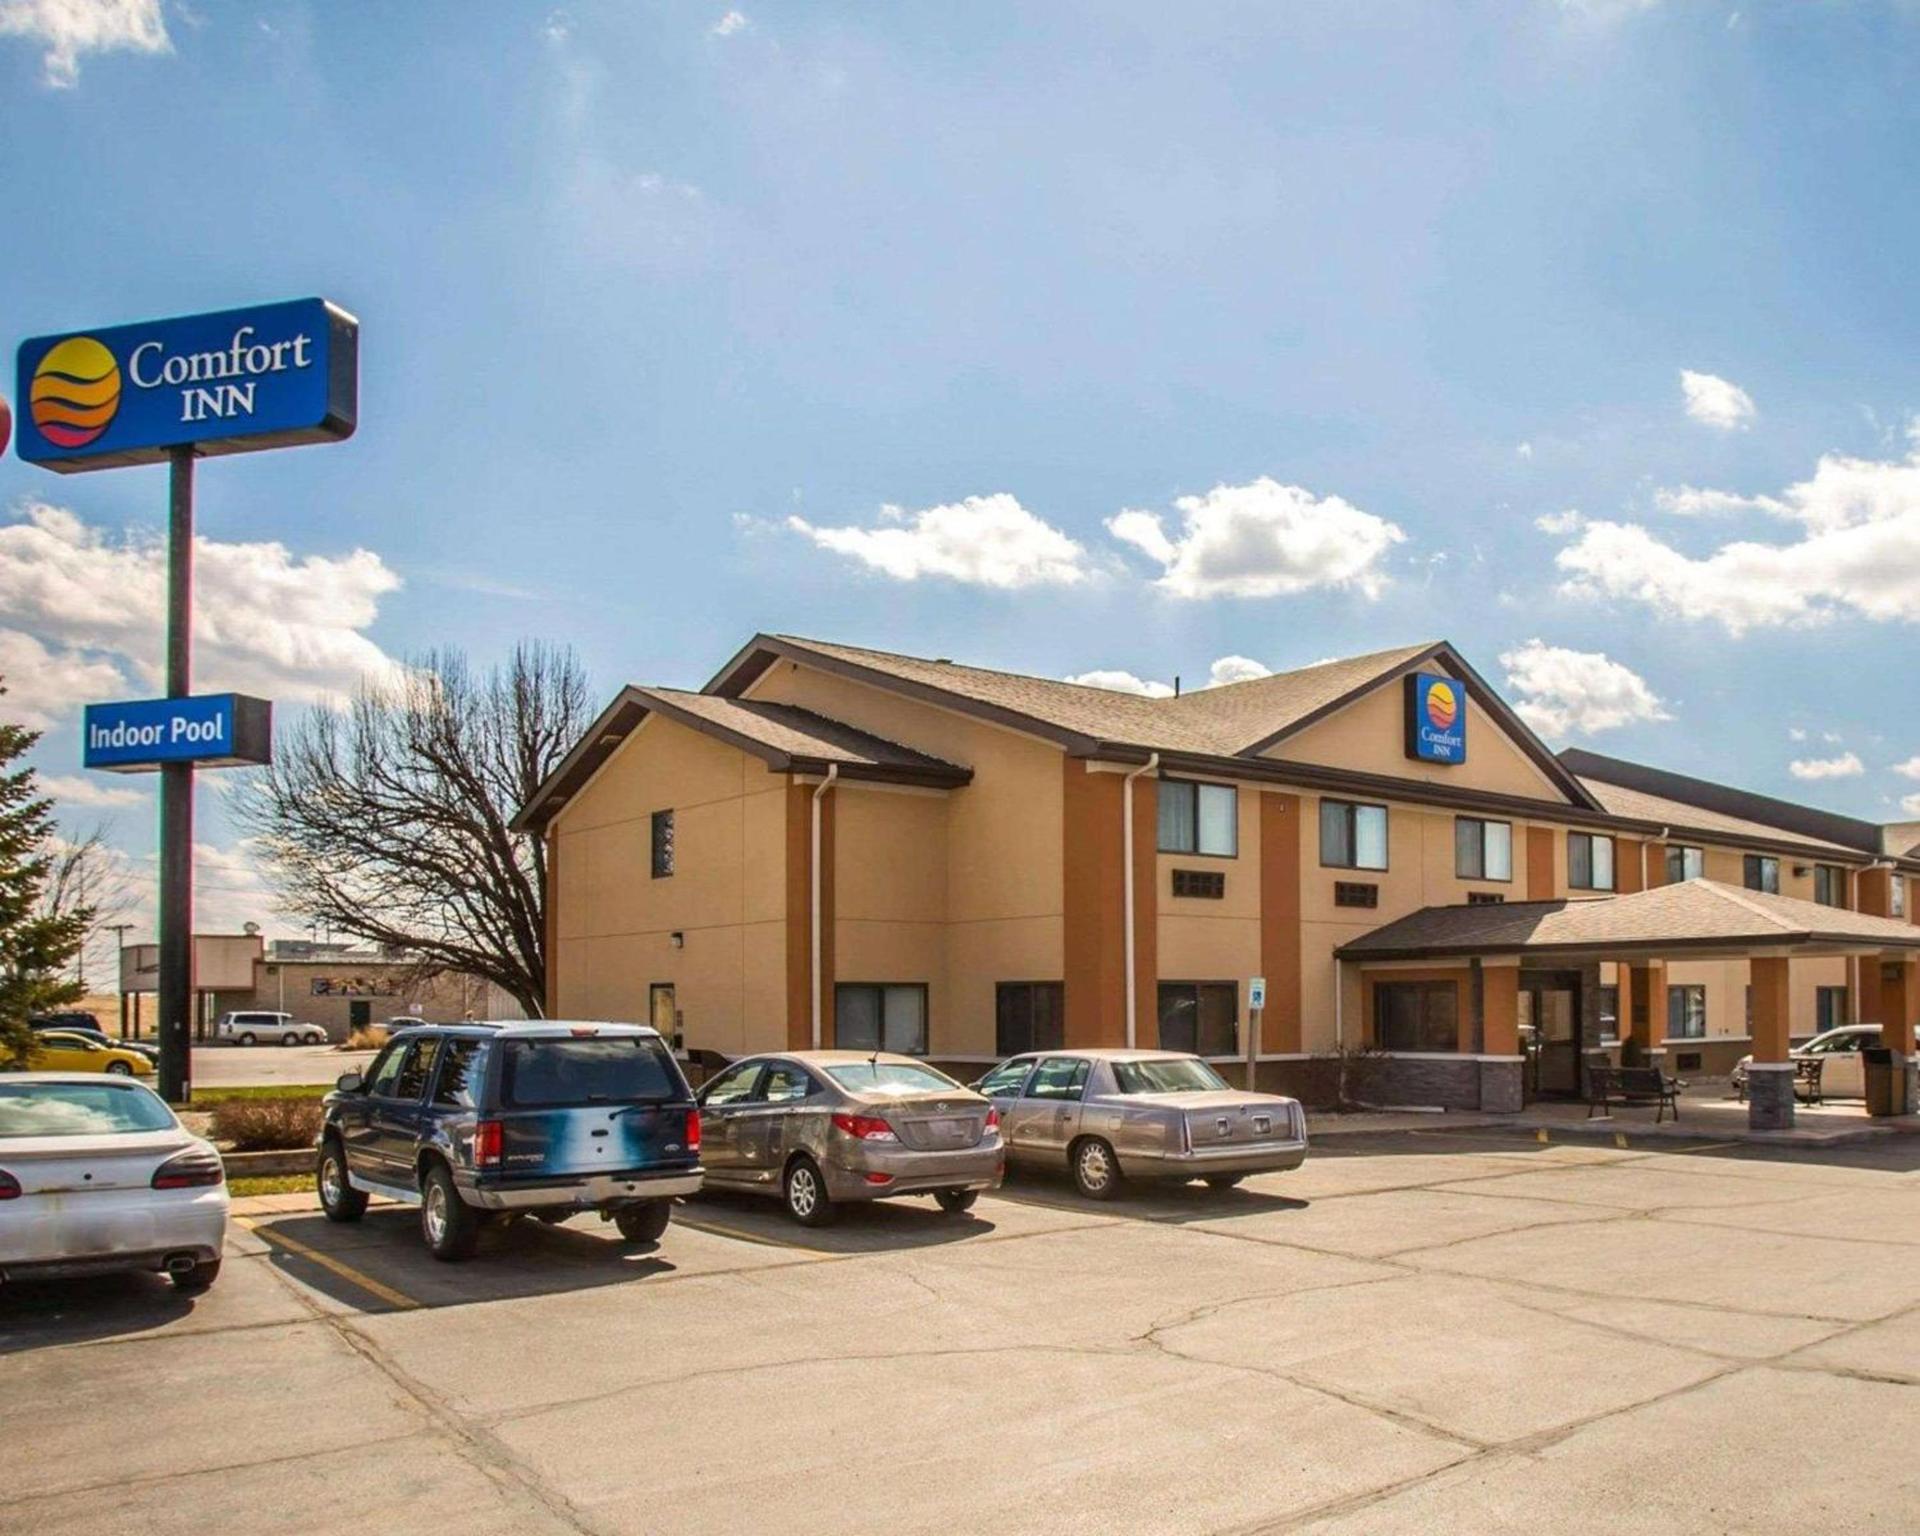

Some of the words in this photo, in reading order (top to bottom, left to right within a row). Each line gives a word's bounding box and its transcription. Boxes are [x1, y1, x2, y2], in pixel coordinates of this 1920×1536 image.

[129, 327, 312, 388] Comfort
[180, 383, 256, 422] INN
[90, 720, 165, 748] Indoor
[171, 712, 223, 743] Pool
[1421, 726, 1462, 747] Comfort
